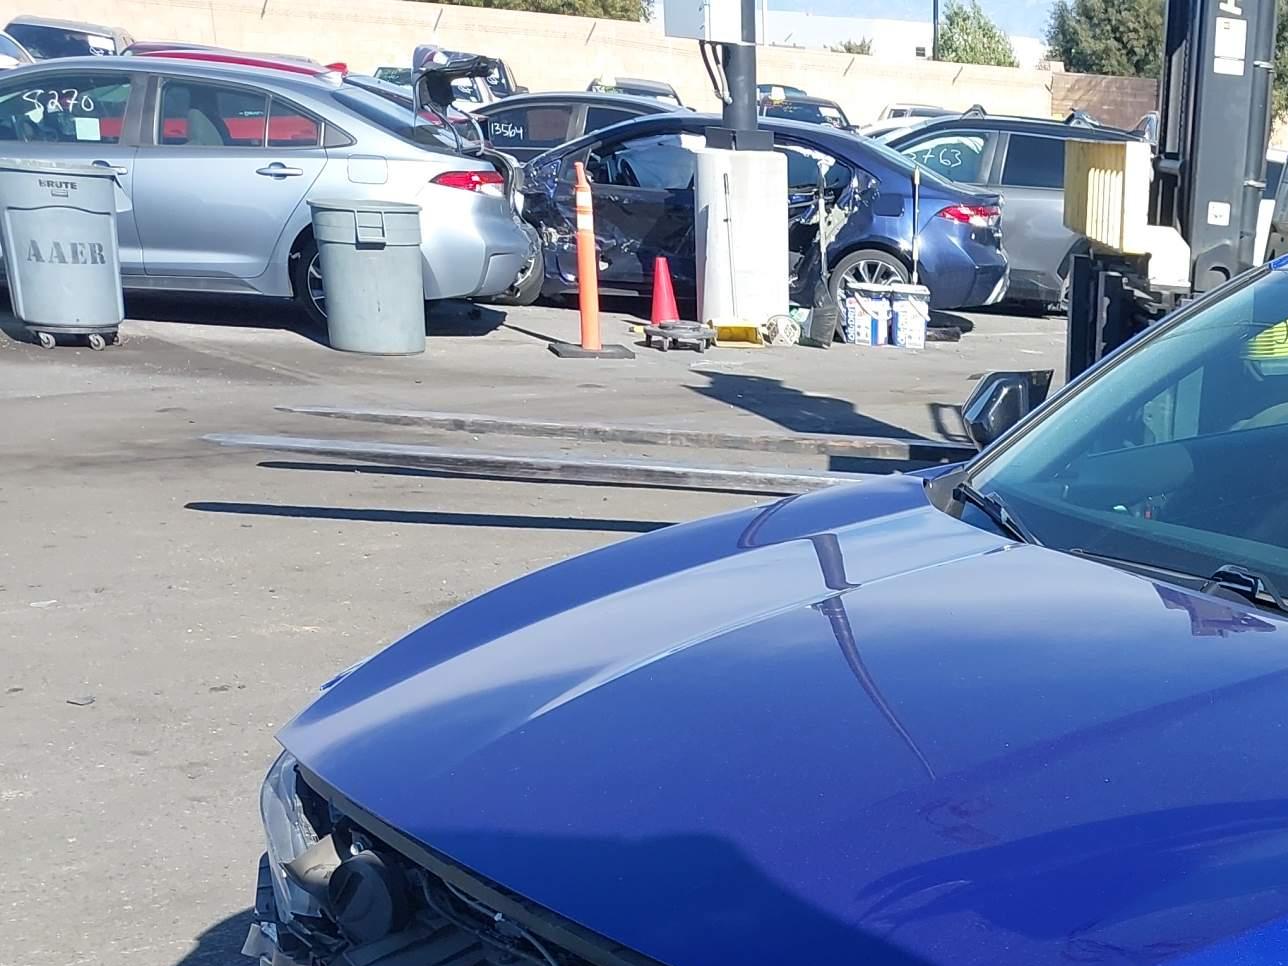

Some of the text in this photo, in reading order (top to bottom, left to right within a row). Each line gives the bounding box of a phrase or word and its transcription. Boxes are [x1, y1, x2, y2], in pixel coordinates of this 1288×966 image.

[491, 122, 523, 141] 13564
[38, 178, 78, 190] BRUTE
[26, 239, 106, 265] AAER
